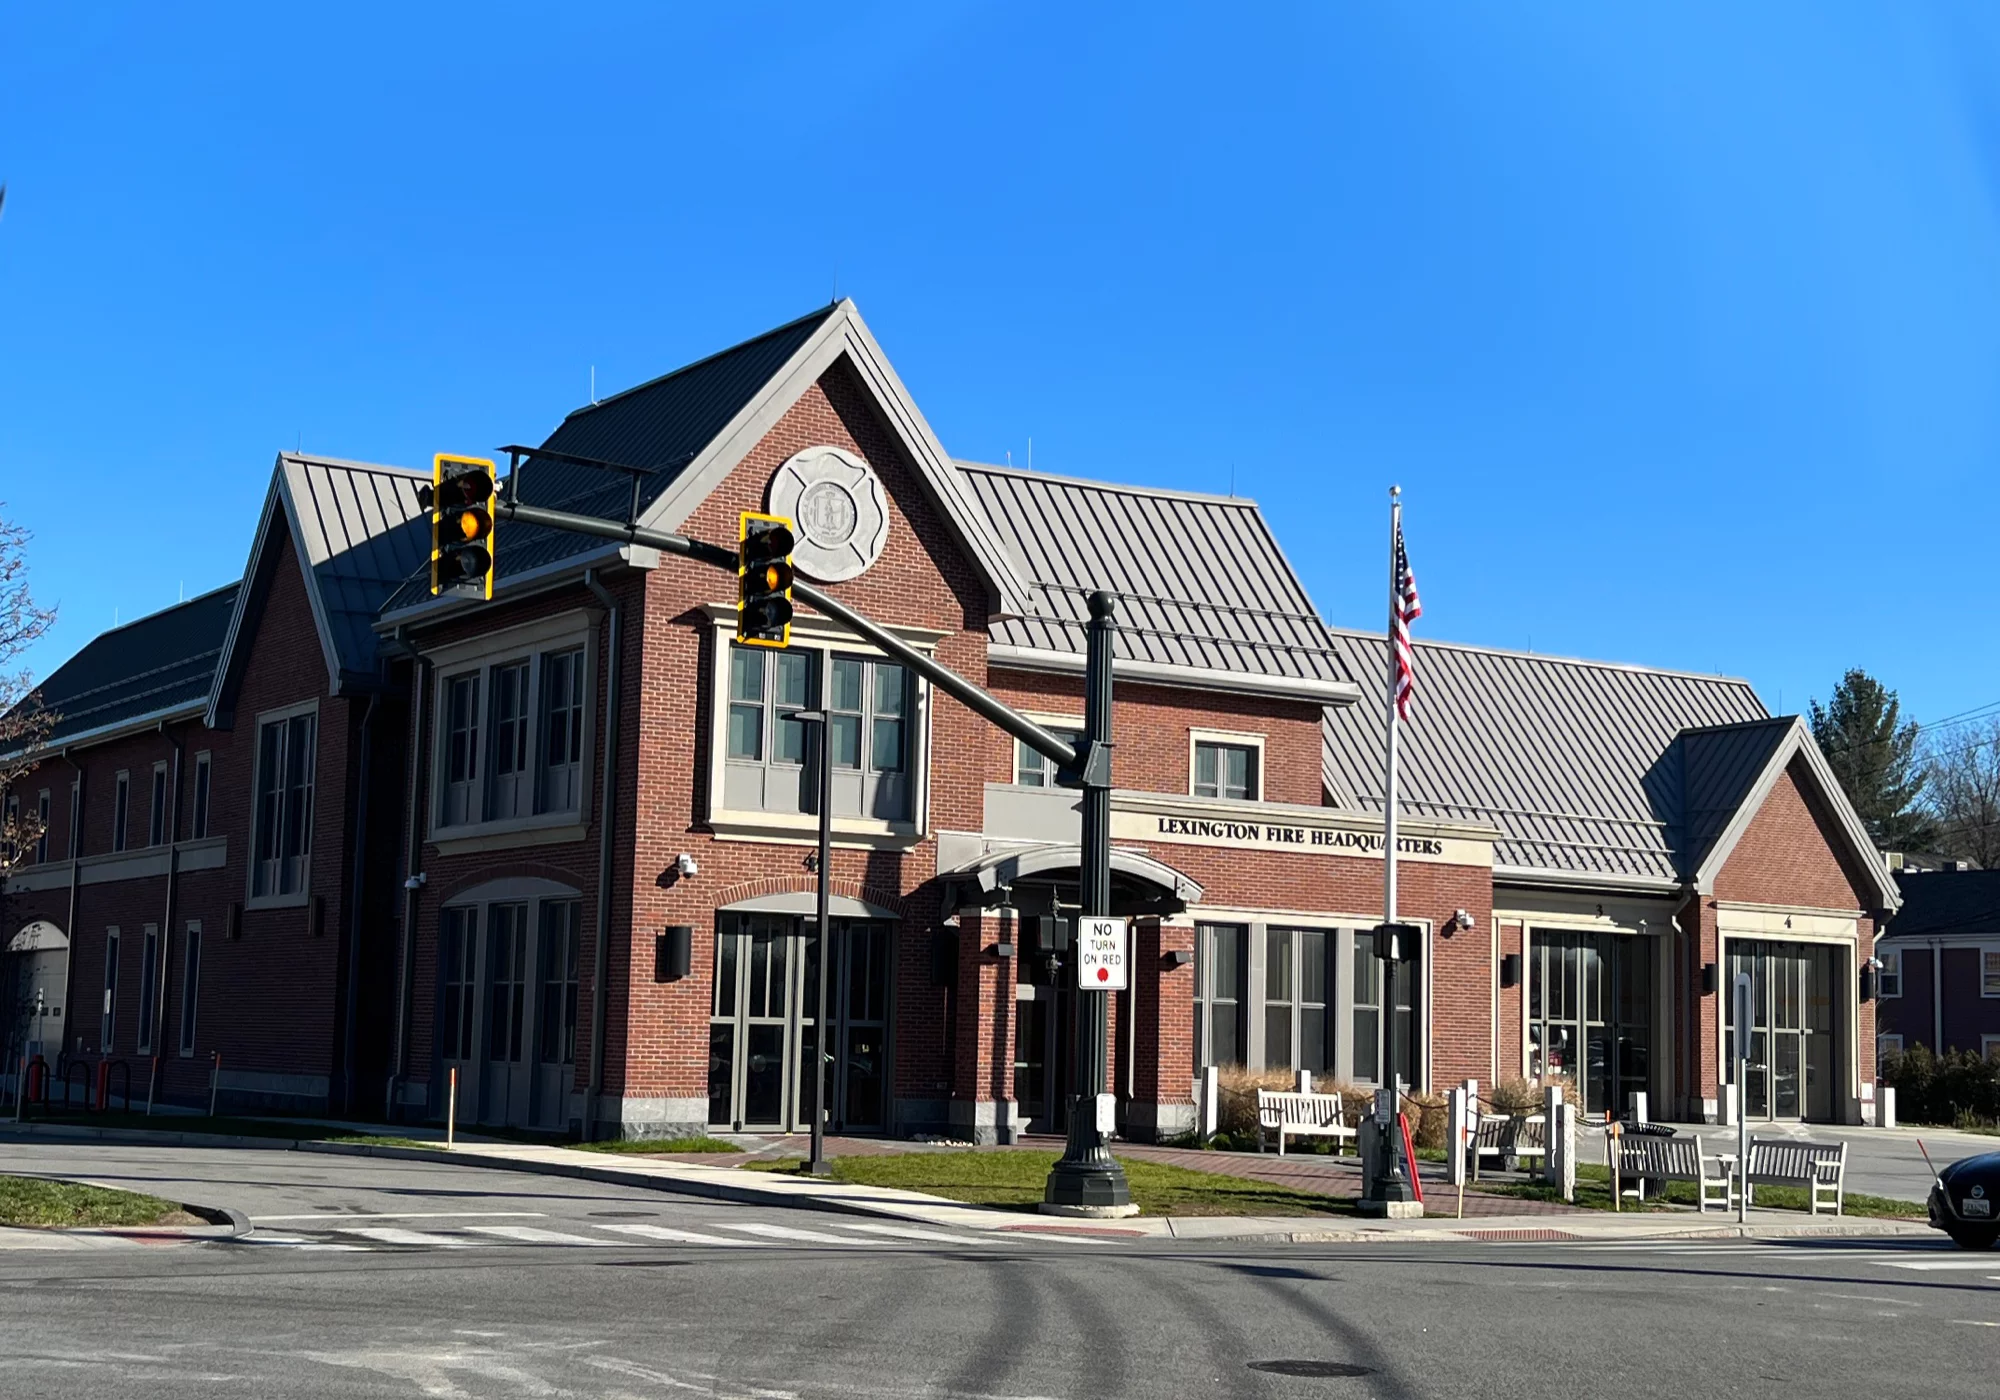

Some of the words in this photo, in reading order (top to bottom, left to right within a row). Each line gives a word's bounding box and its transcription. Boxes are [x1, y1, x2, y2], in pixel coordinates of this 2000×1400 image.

[1158, 818, 1259, 841] LEXINGTON
[1266, 827, 1305, 844] FIRE
[1595, 903, 1603, 919] 3
[1784, 914, 1792, 929] 4
[1093, 922, 1112, 936] NO
[1090, 939, 1116, 951] TURN
[1084, 953, 1097, 965] ON
[1102, 954, 1121, 965] RED
